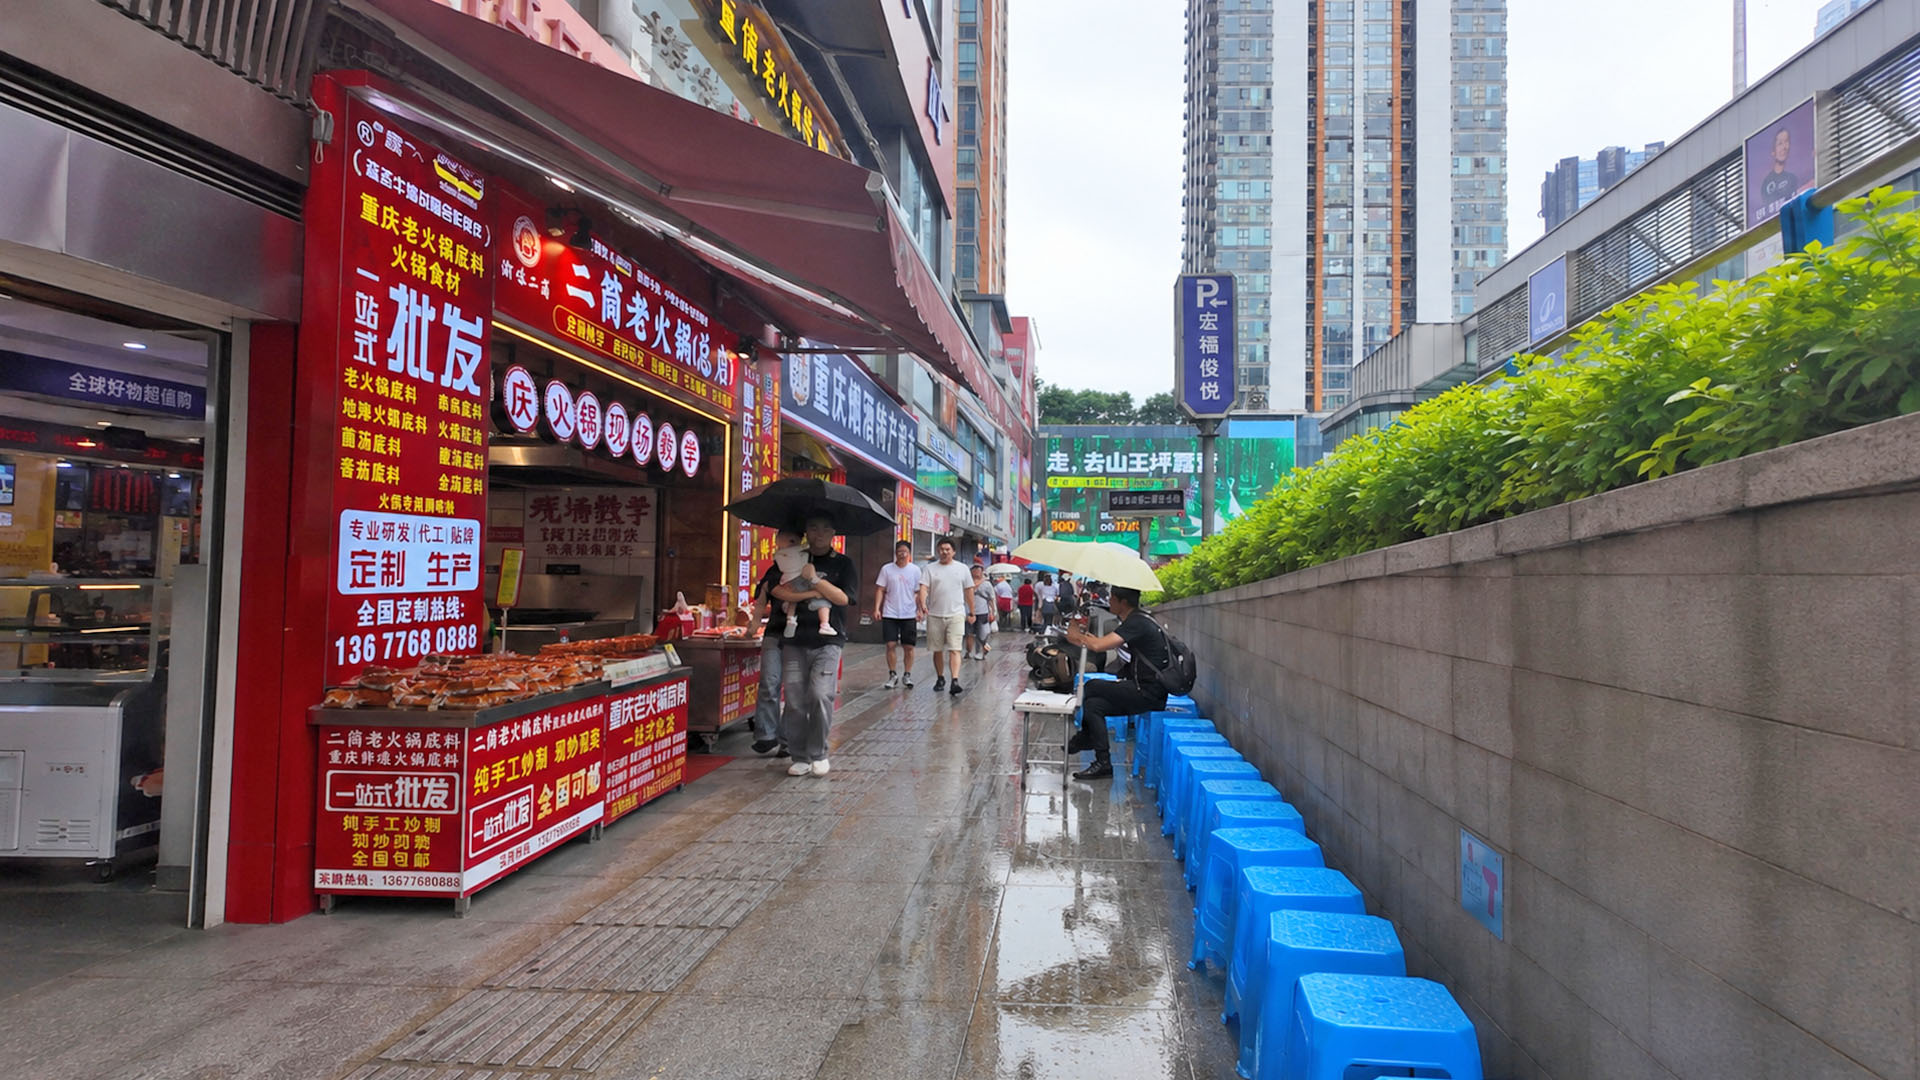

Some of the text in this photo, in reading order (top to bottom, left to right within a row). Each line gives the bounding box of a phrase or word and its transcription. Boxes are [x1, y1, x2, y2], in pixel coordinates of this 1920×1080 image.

[360, 192, 485, 278] 重庆老火锅底料
[391, 244, 461, 296] 火锅食材
[1197, 278, 1219, 308] P
[353, 267, 380, 367] 一站式
[386, 282, 484, 397] 批发
[1199, 312, 1220, 400] 宏福俊悦
[69, 372, 192, 410] 全球好物超值购
[344, 367, 417, 405] 老火锅底料
[349, 518, 410, 543] 专业研发
[349, 549, 406, 589] 定制
[427, 551, 472, 587] 生产
[335, 623, 478, 666] 136 7768 0888
[335, 776, 450, 809] 一站式批发
[351, 850, 431, 869] 全国包邮
[381, 875, 461, 889] 13677680888
